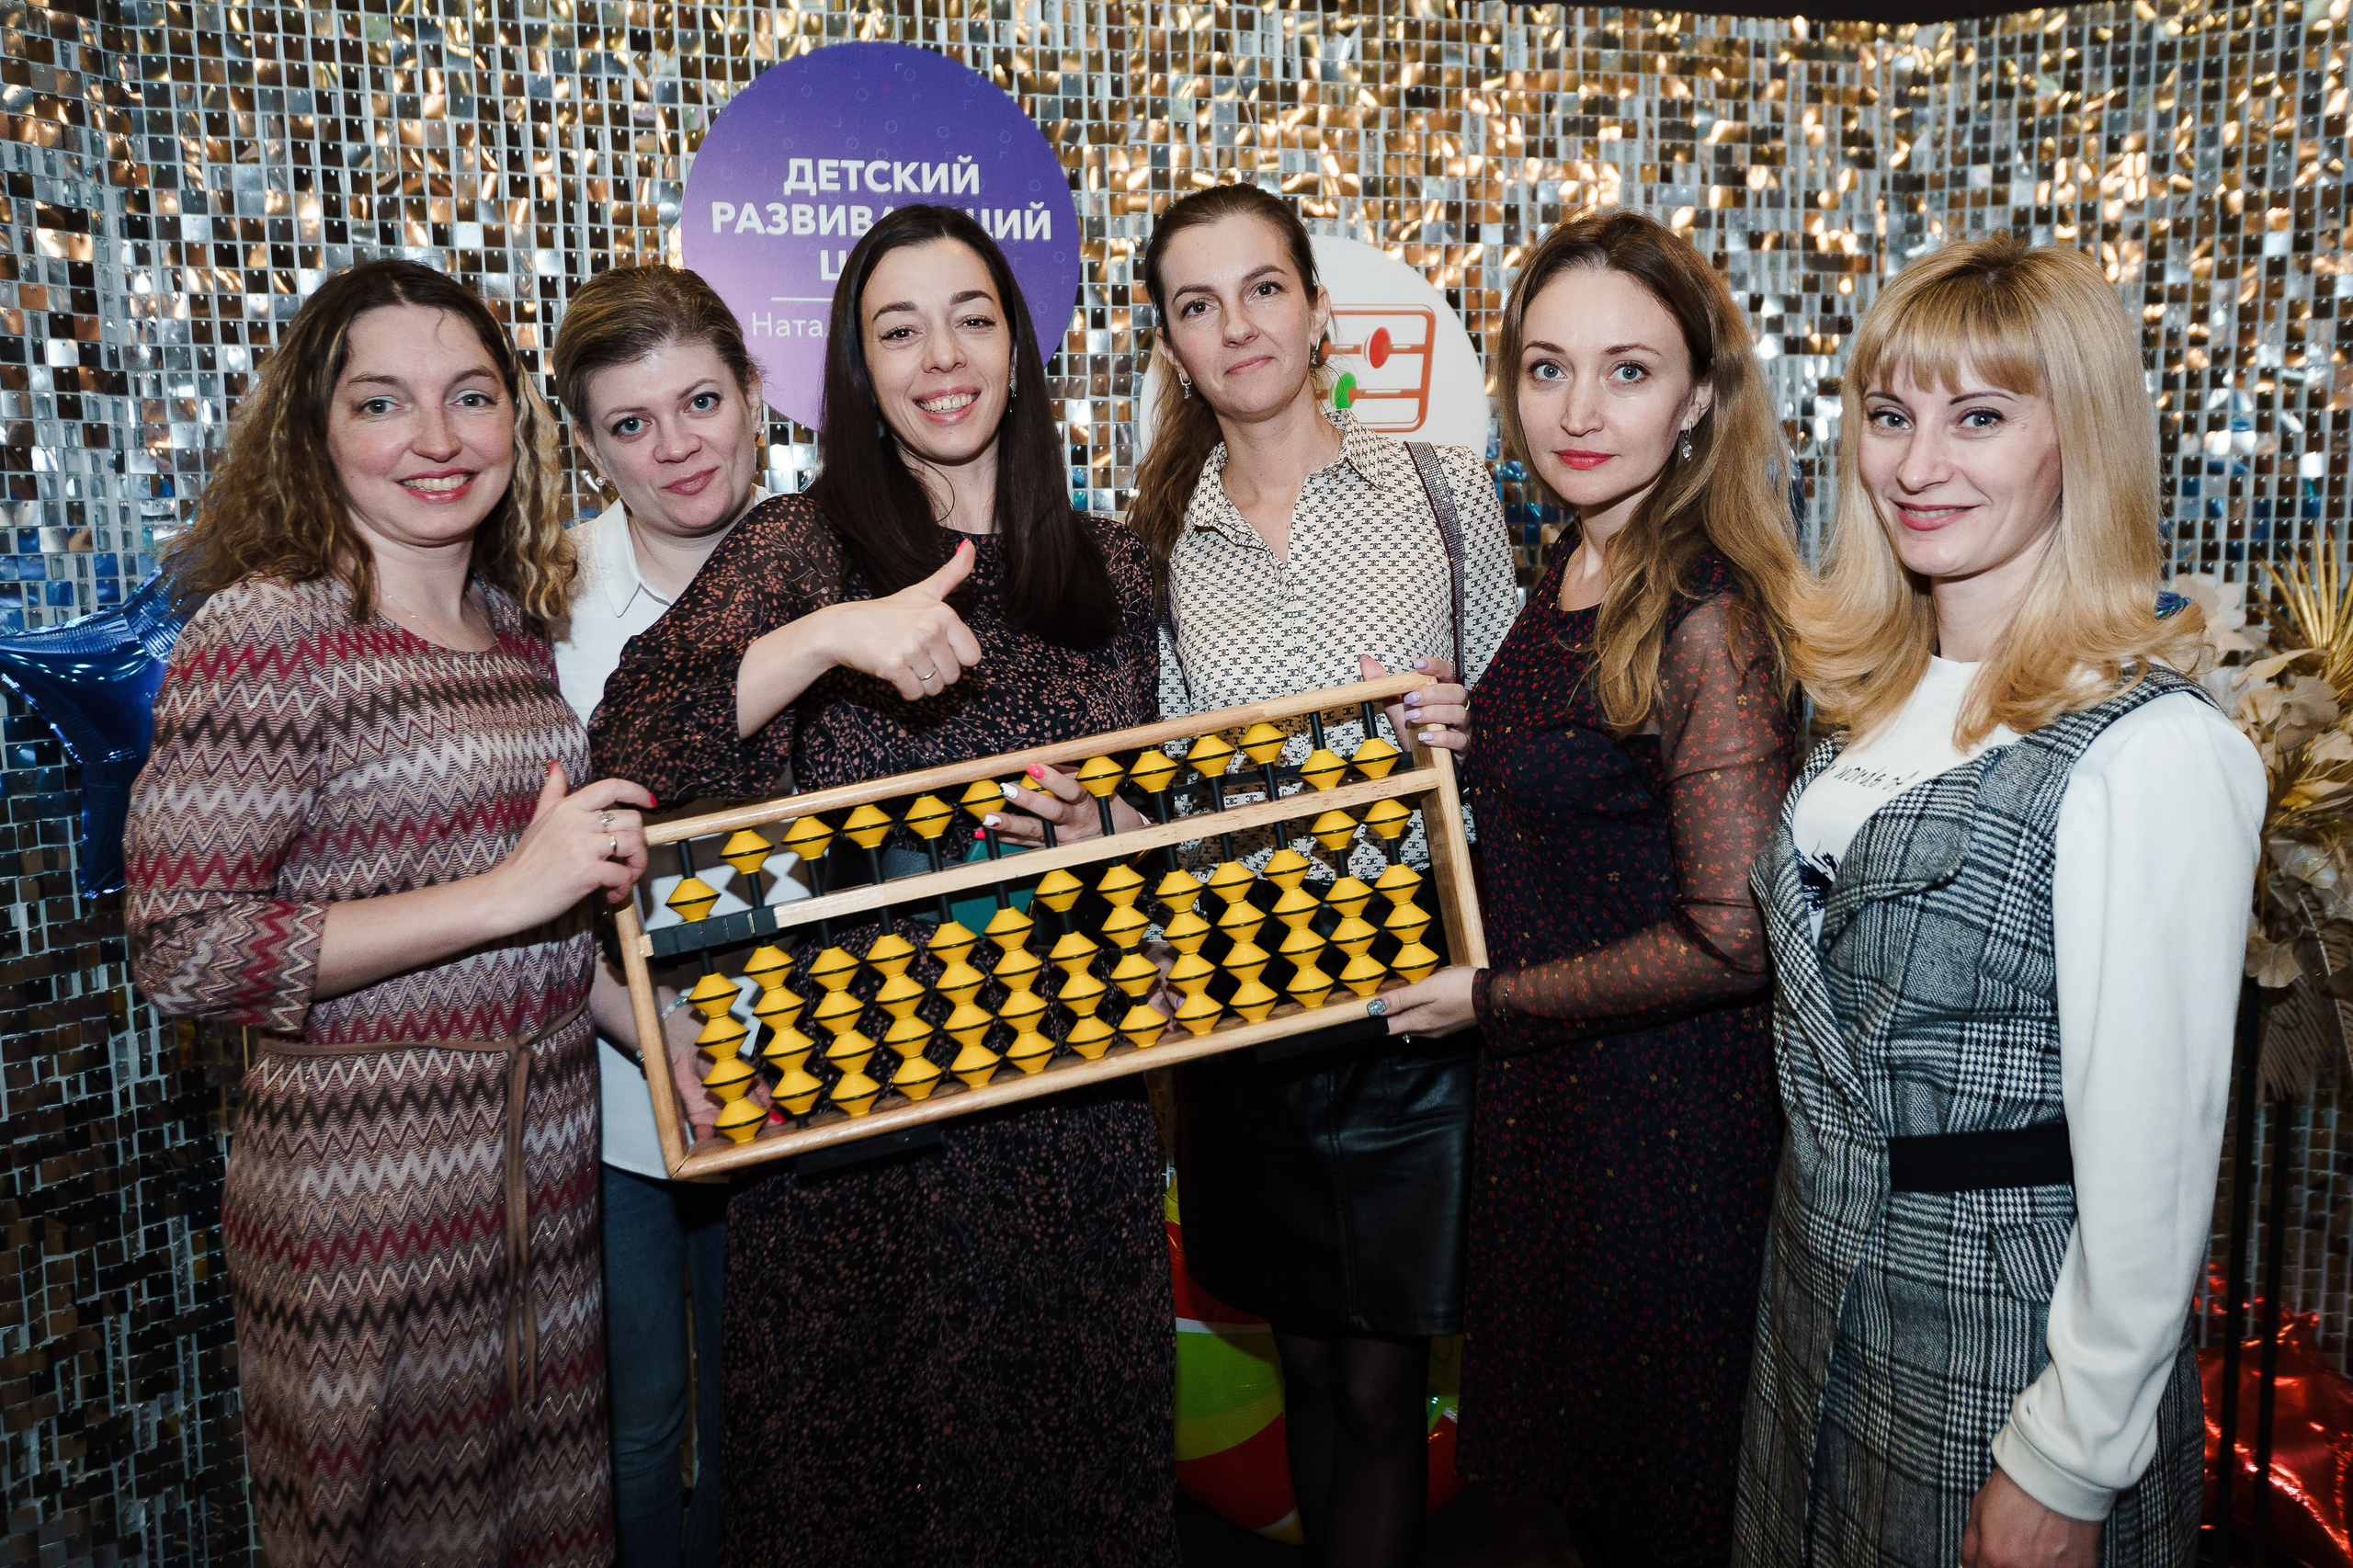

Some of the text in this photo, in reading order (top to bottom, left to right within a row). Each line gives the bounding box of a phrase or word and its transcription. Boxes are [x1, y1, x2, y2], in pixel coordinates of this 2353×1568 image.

[783, 154, 981, 196] ДЕТСКИЙ
[711, 200, 1052, 241] РАЗВИВИЙ
[752, 311, 829, 338] Ната
